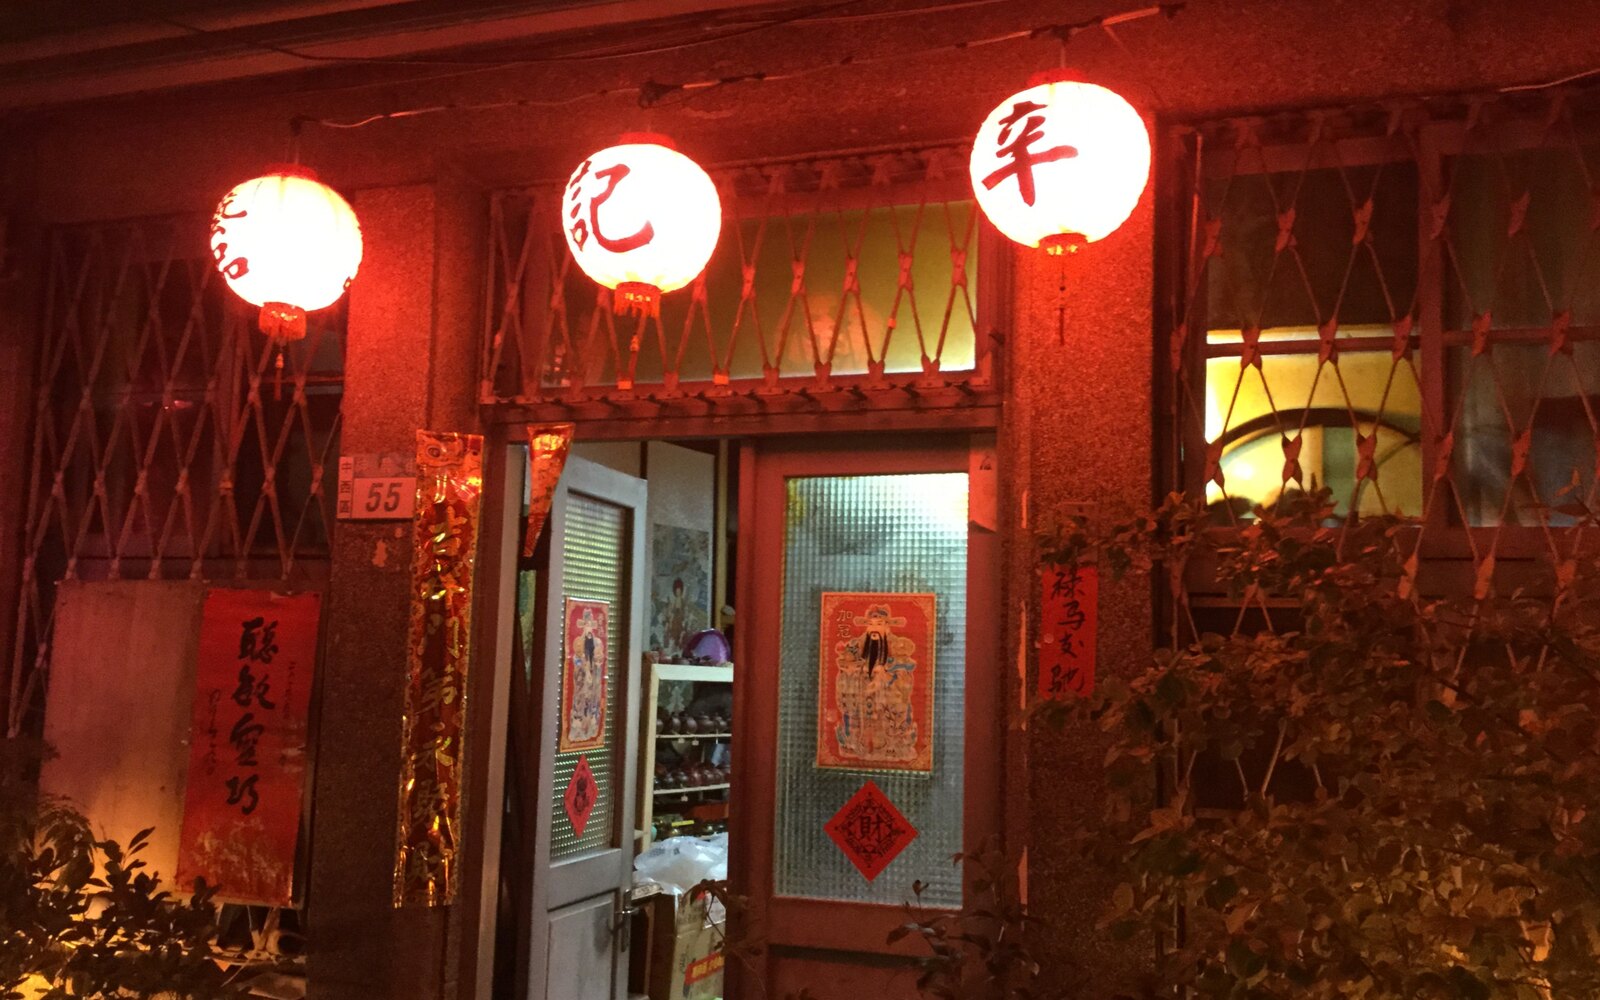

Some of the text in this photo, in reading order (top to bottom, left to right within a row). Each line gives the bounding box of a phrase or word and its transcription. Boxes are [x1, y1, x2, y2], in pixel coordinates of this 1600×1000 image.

[569, 160, 655, 253] 記
[365, 482, 403, 512] 55
[836, 609, 854, 638] 加冠
[858, 814, 884, 842] 財
